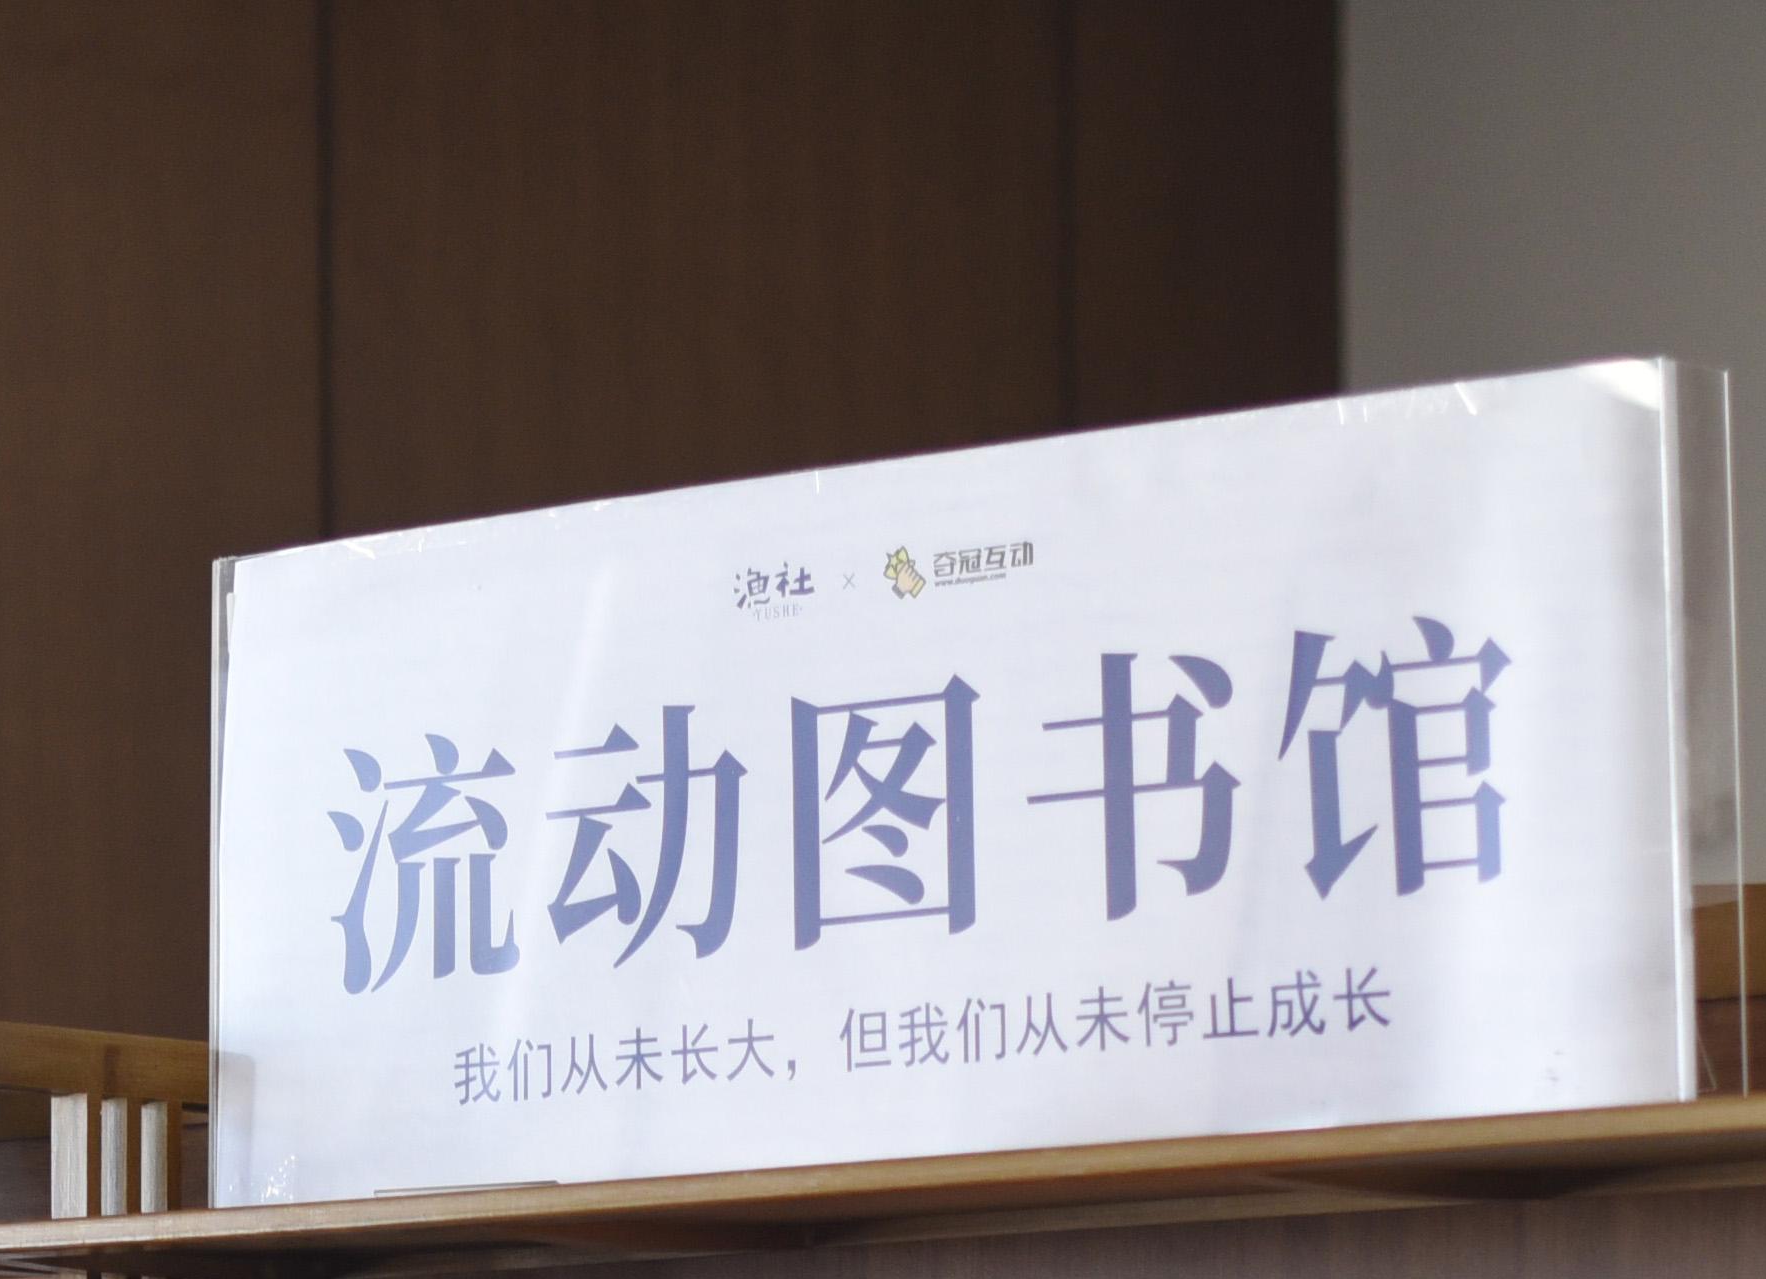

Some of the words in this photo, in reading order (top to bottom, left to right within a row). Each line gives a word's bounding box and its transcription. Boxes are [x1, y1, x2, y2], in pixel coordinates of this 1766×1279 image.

[933, 541, 1034, 577] 夺冠互动
[328, 616, 1512, 997] 流动图书馆
[454, 964, 1393, 1110] 我们从未长大，但我们从未停止成长
